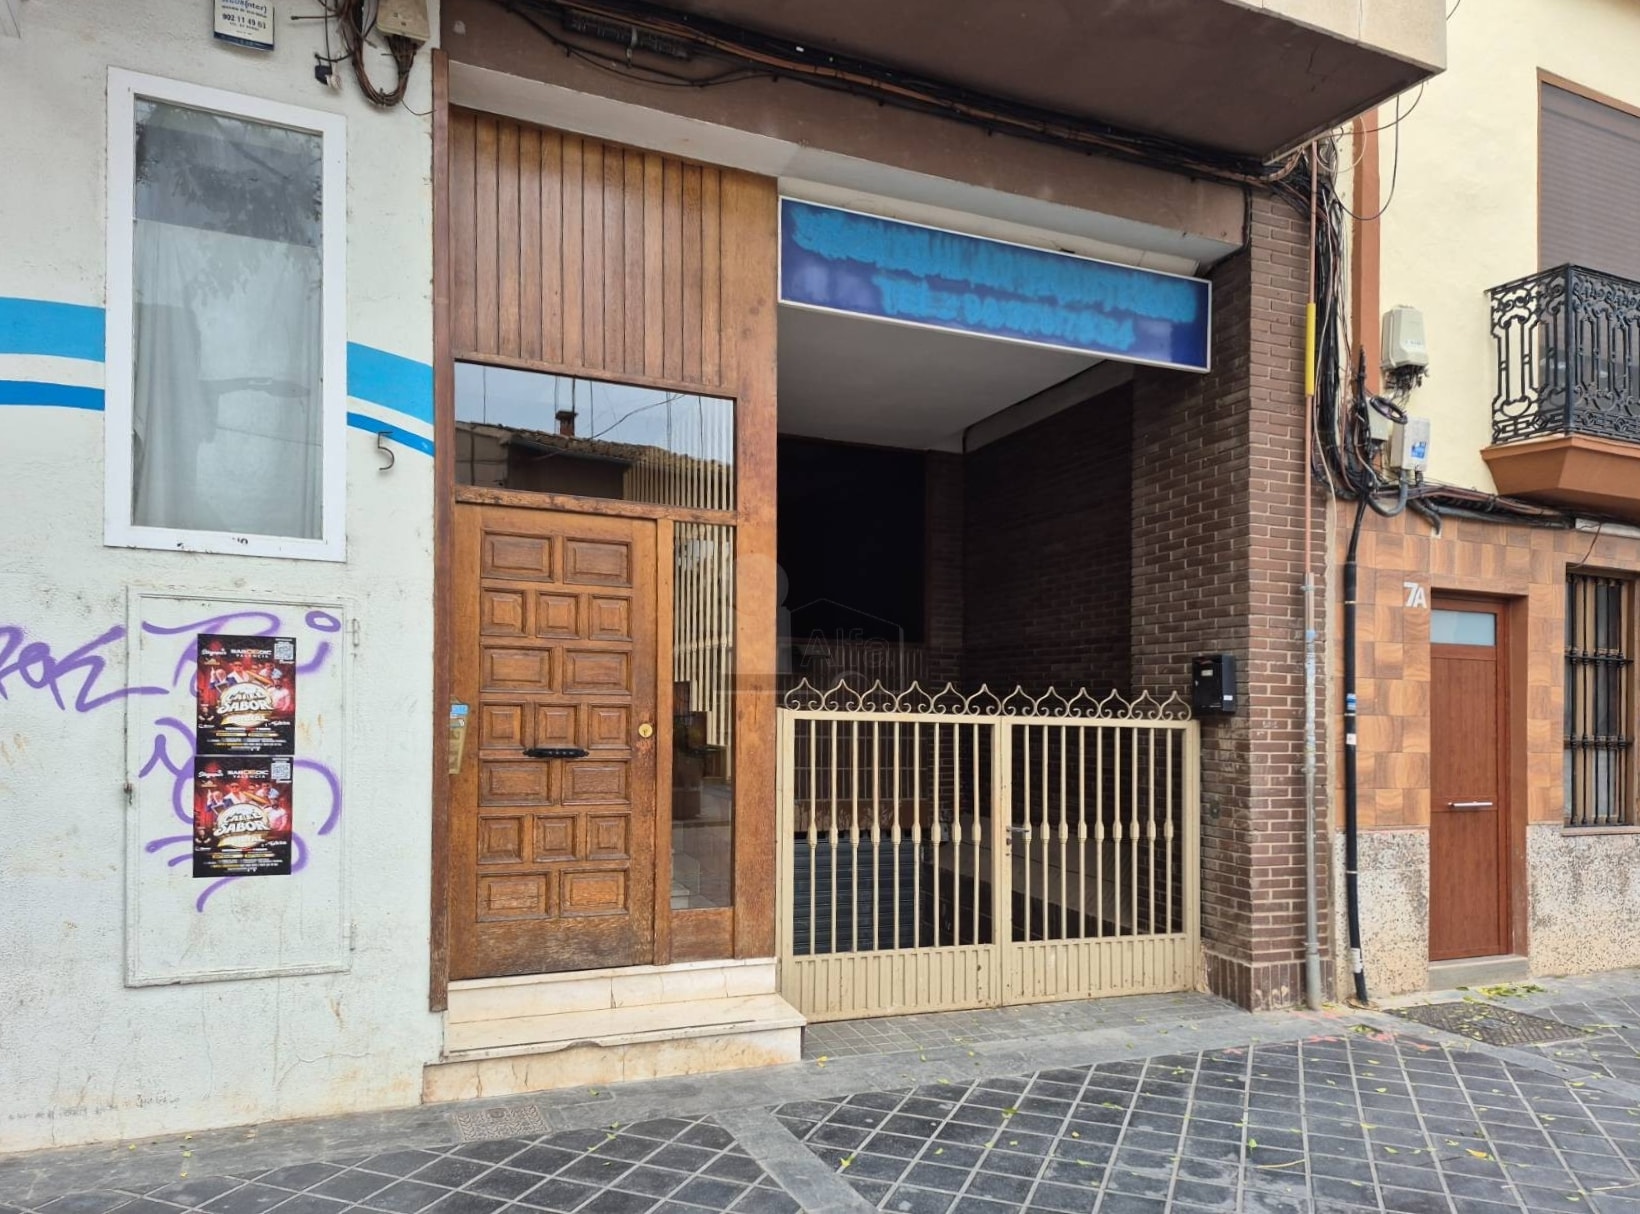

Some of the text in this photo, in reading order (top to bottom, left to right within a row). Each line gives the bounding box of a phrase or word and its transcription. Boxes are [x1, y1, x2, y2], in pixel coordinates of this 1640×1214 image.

[222, 13, 235, 22] 902
[1403, 581, 1427, 609] 7A
[216, 700, 275, 714] SABOR
[212, 820, 272, 836] SABOR
